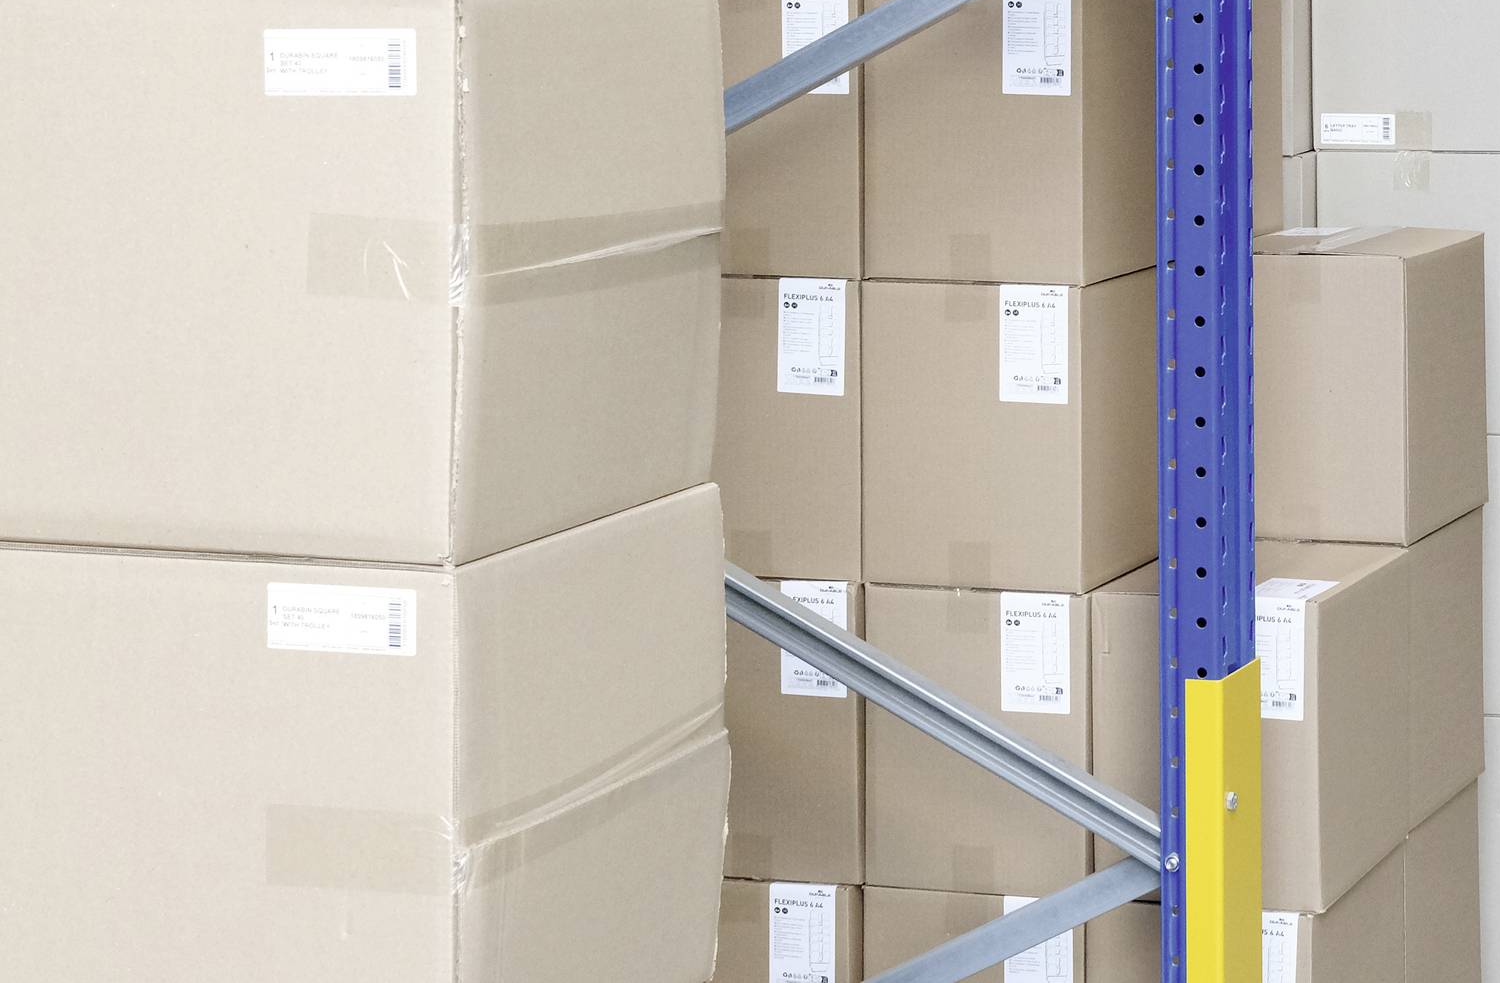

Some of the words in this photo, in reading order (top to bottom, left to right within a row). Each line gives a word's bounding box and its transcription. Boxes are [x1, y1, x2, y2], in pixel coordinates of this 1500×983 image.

[270, 52, 275, 61] 1
[783, 293, 818, 301] FLEXIPLUS
[1004, 300, 1040, 308] FLEXIPLUS
[273, 605, 277, 615] 1
[1005, 610, 1041, 618] FLEXIPLUS
[1256, 615, 1276, 623] IPLUS
[774, 898, 808, 907] FLEXIPLUS
